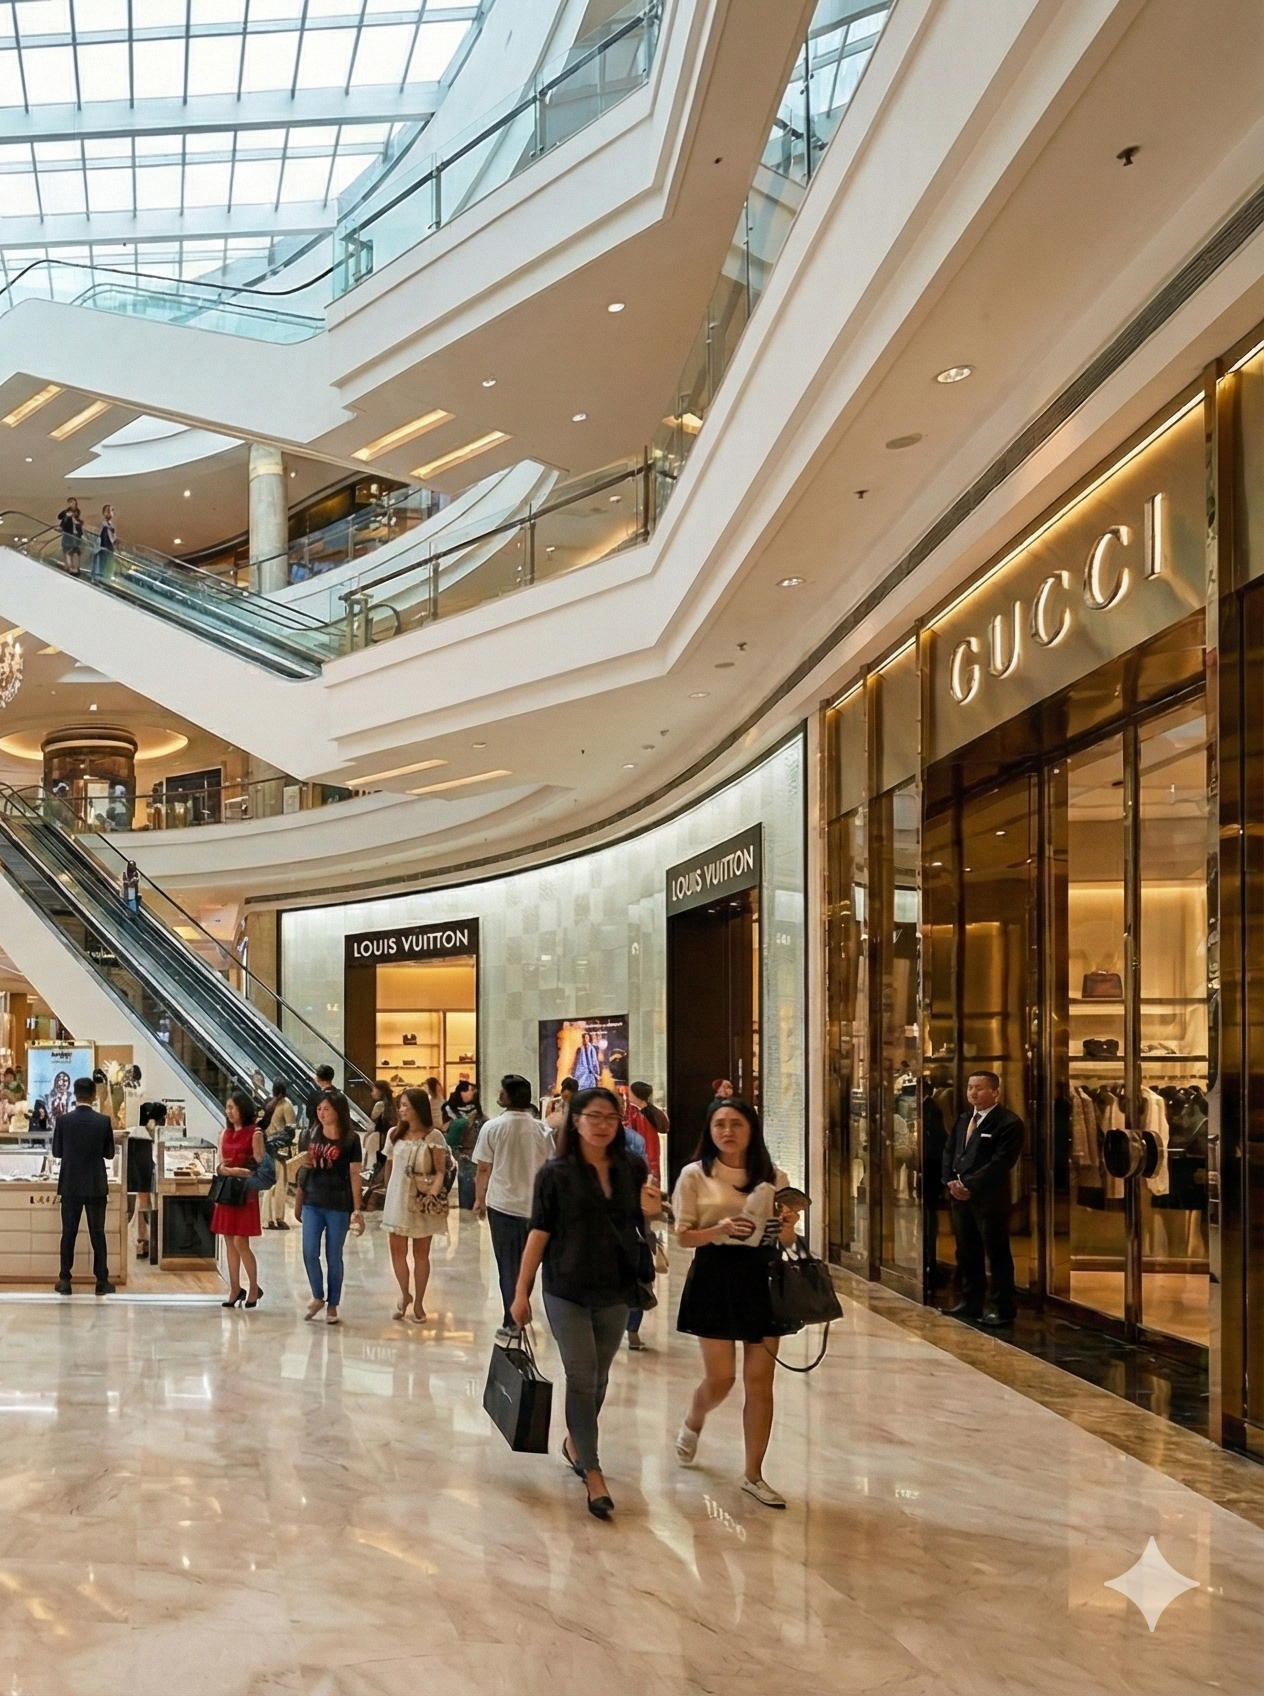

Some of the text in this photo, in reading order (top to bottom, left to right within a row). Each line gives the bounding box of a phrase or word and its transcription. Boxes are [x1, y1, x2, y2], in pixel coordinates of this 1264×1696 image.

[949, 491, 1163, 705] GUCCI
[703, 845, 754, 889] VUITTON
[353, 928, 468, 957] LOUIS VUITTON
